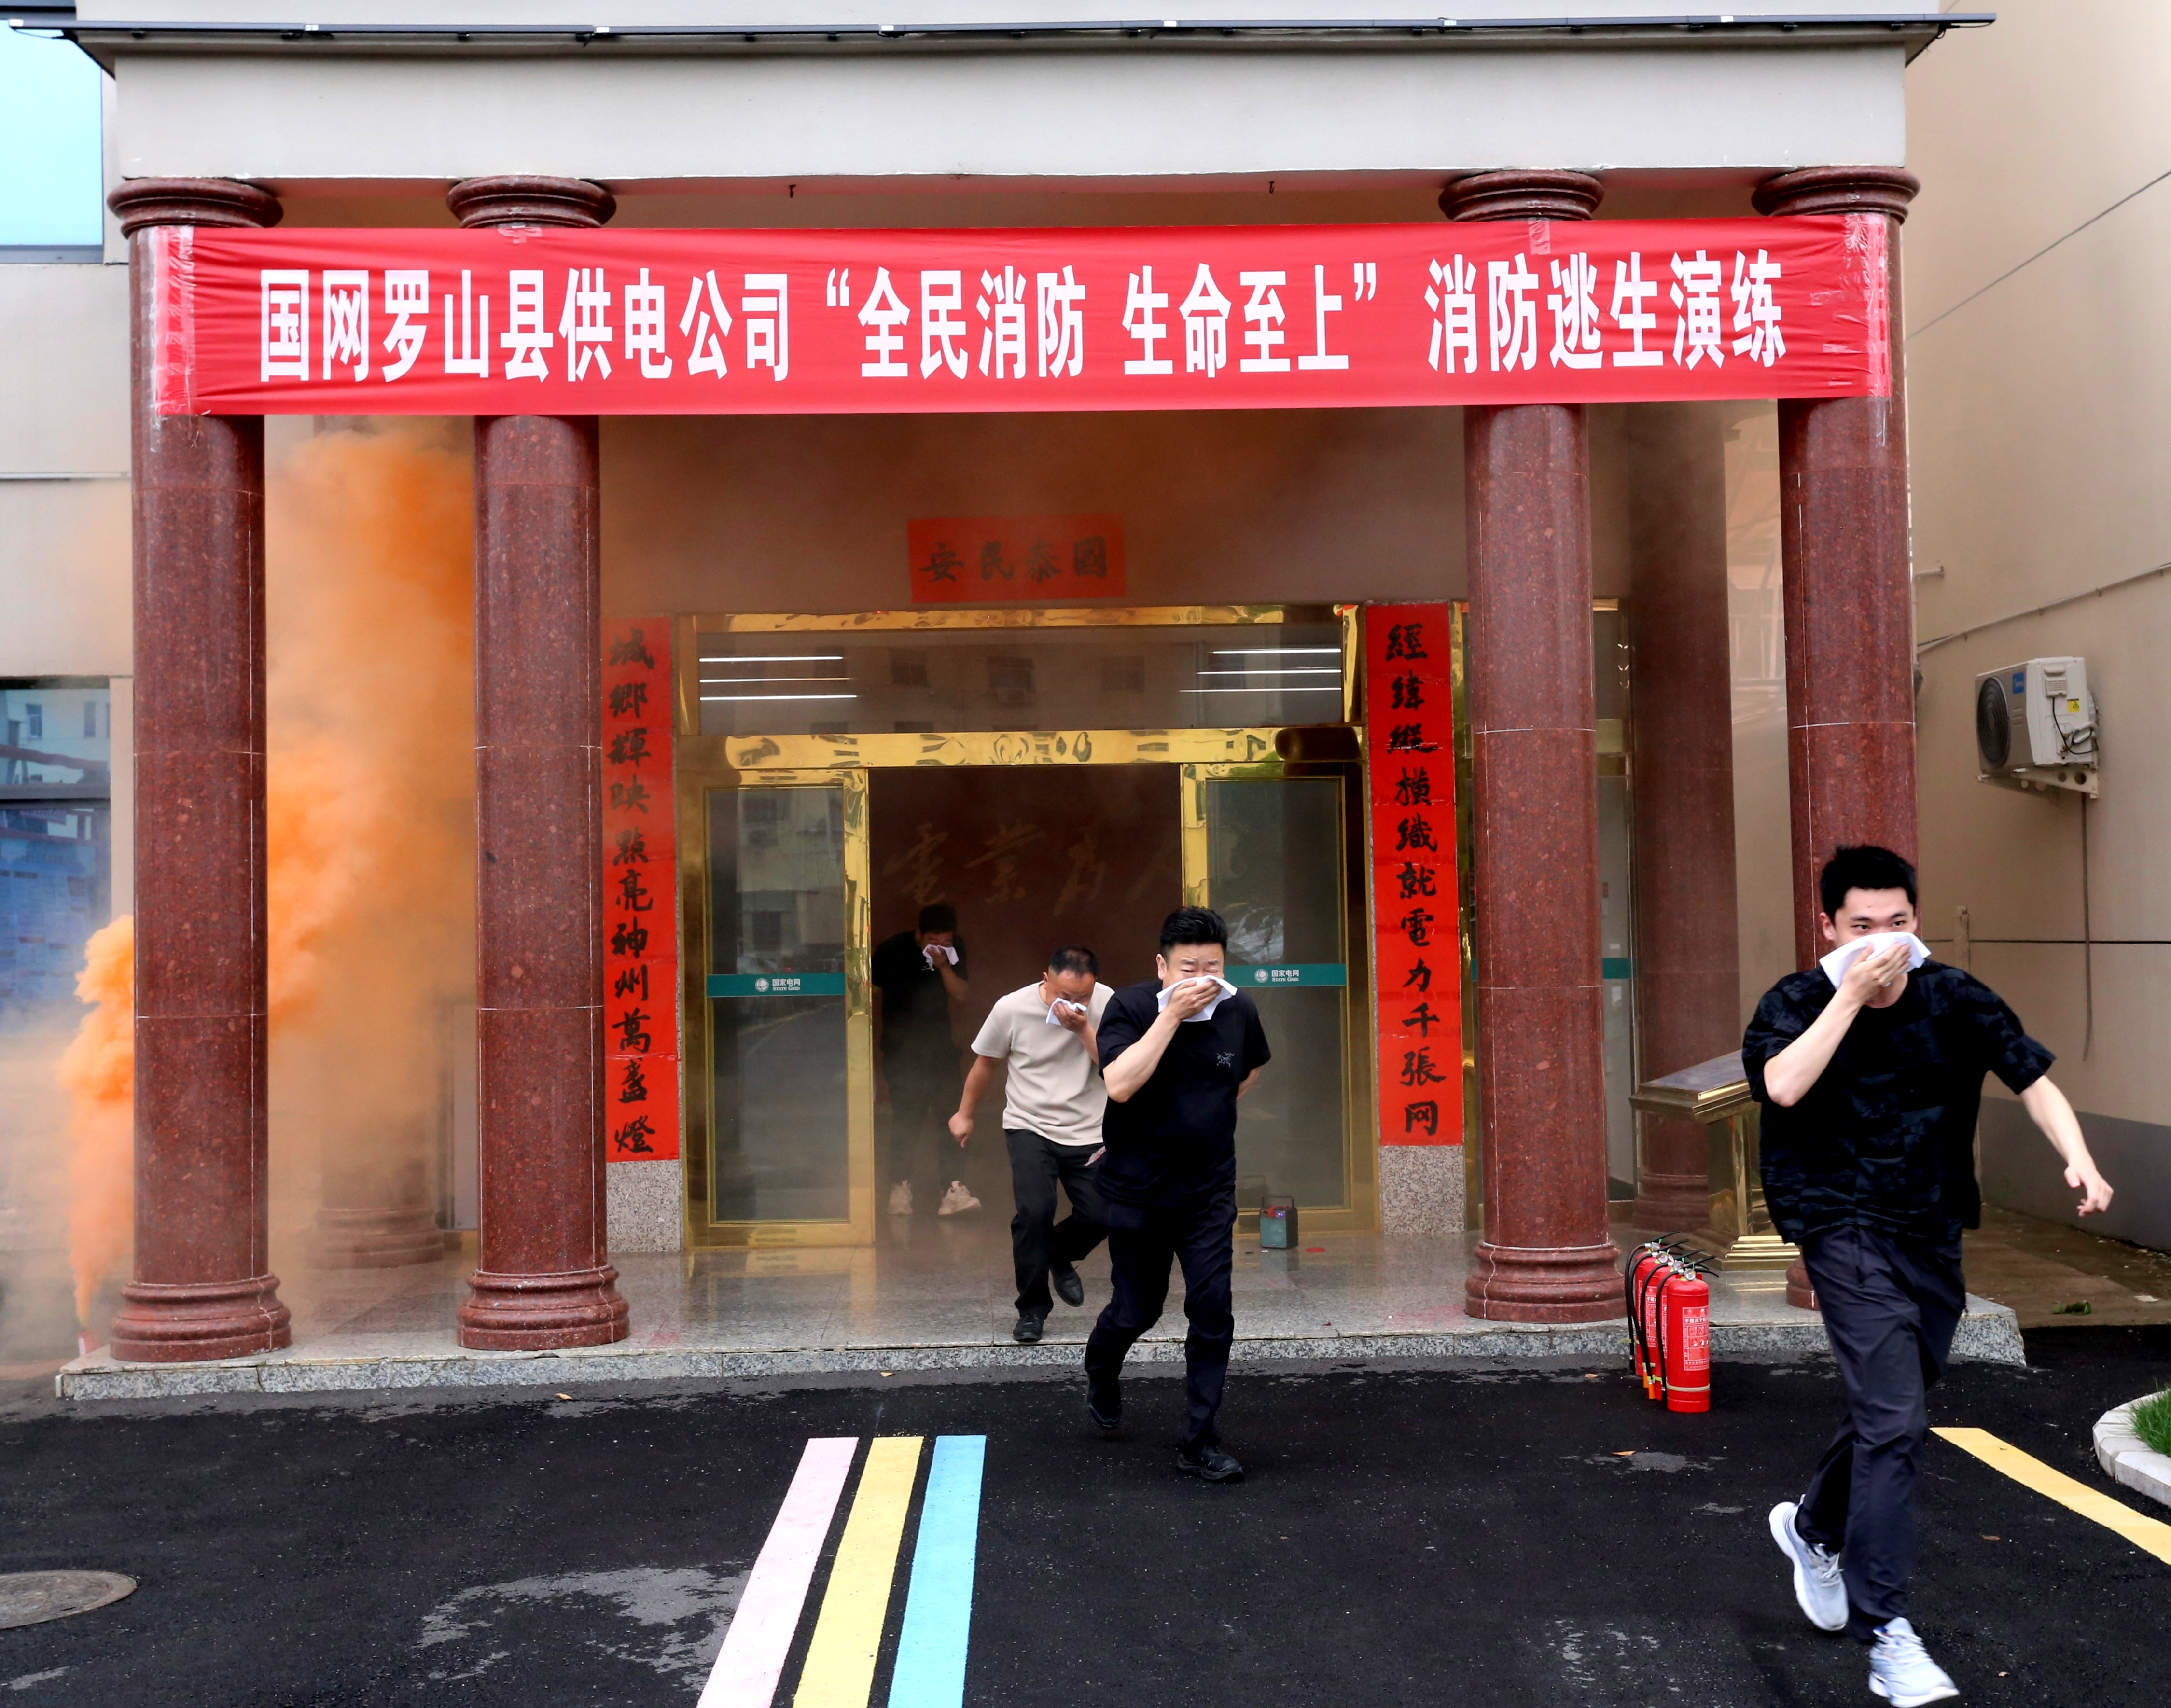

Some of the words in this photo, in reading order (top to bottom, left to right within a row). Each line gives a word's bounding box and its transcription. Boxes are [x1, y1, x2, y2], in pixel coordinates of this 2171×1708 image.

[261, 267, 789, 382] 国网罗山县供电公司
[1424, 249, 1787, 374] 消防逃生演练
[1271, 969, 1299, 977] 国家电网
